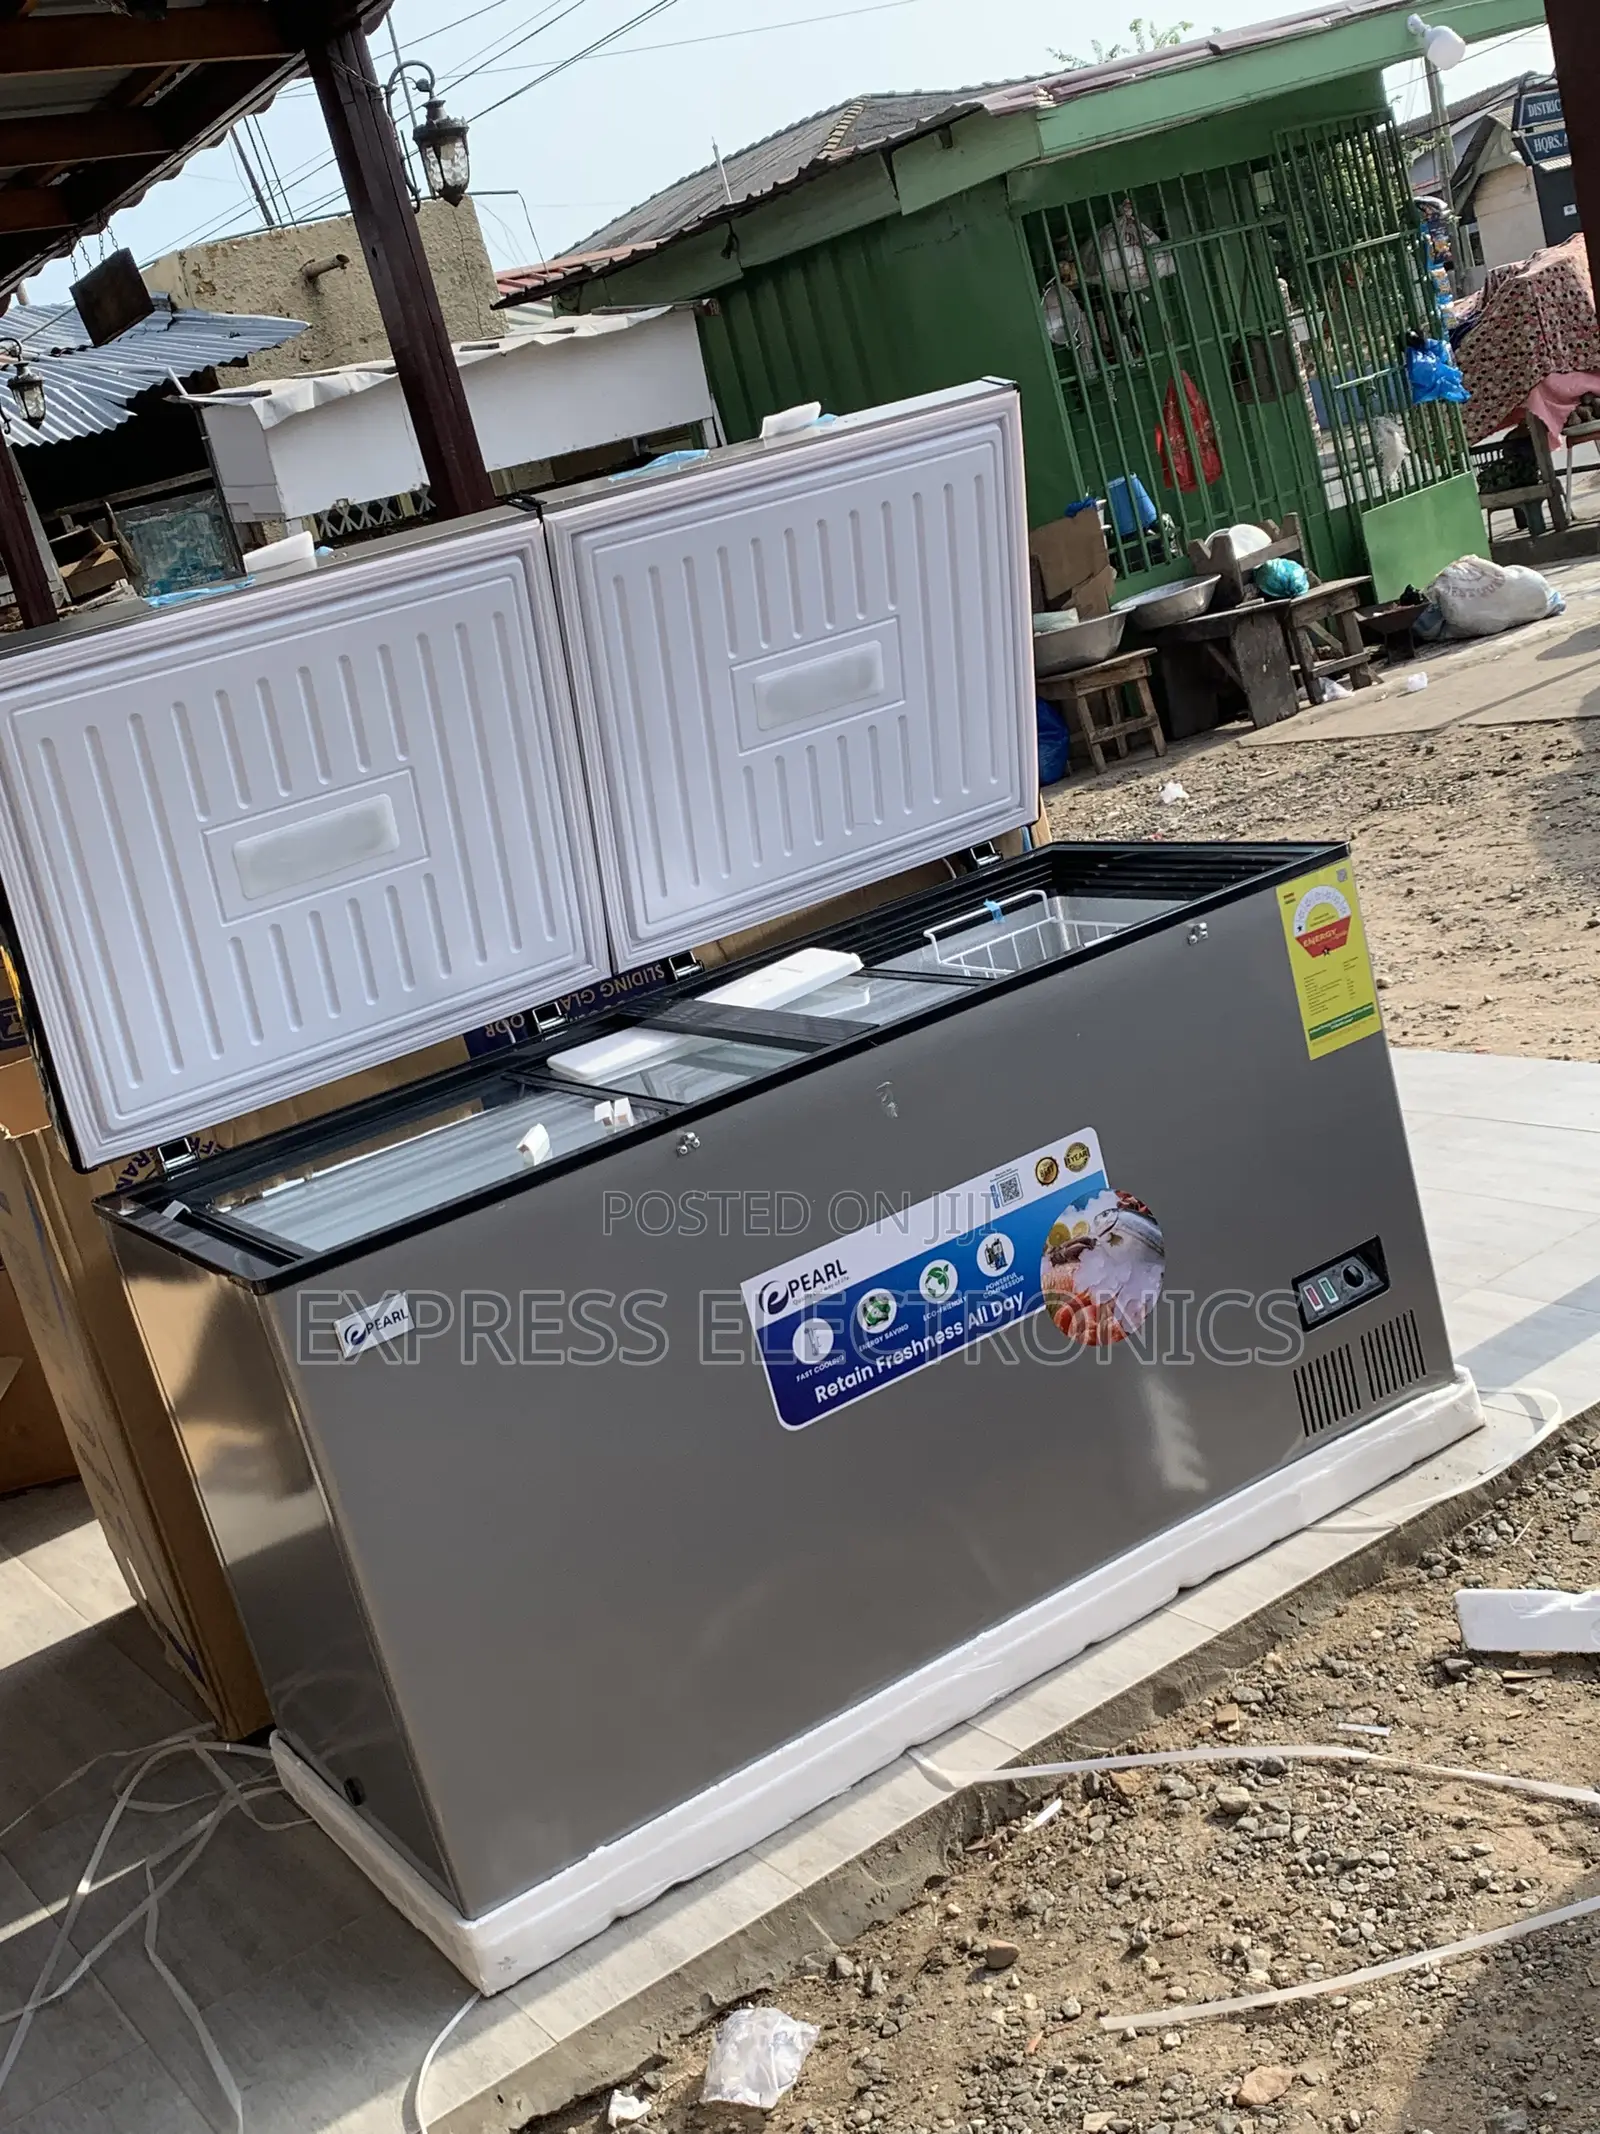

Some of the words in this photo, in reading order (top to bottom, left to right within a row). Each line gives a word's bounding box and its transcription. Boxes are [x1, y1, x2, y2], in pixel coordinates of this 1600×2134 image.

[1527, 99, 1562, 117] DISTRIC
[599, 963, 665, 998] SLIDING
[559, 988, 596, 1012] GLA
[484, 1013, 525, 1038] OOR
[787, 1258, 848, 1298] PEARL
[982, 1275, 1026, 1299] COMPRESSOR
[984, 1271, 1019, 1291] POWERFUL
[365, 1307, 410, 1335] PEARL
[884, 1322, 909, 1340] SAVING
[814, 1364, 875, 1404] Retain
[874, 1321, 965, 1374] Freshness
[967, 1306, 989, 1330] All
[990, 1290, 1025, 1318] Day
[795, 1369, 814, 1383] FAST
